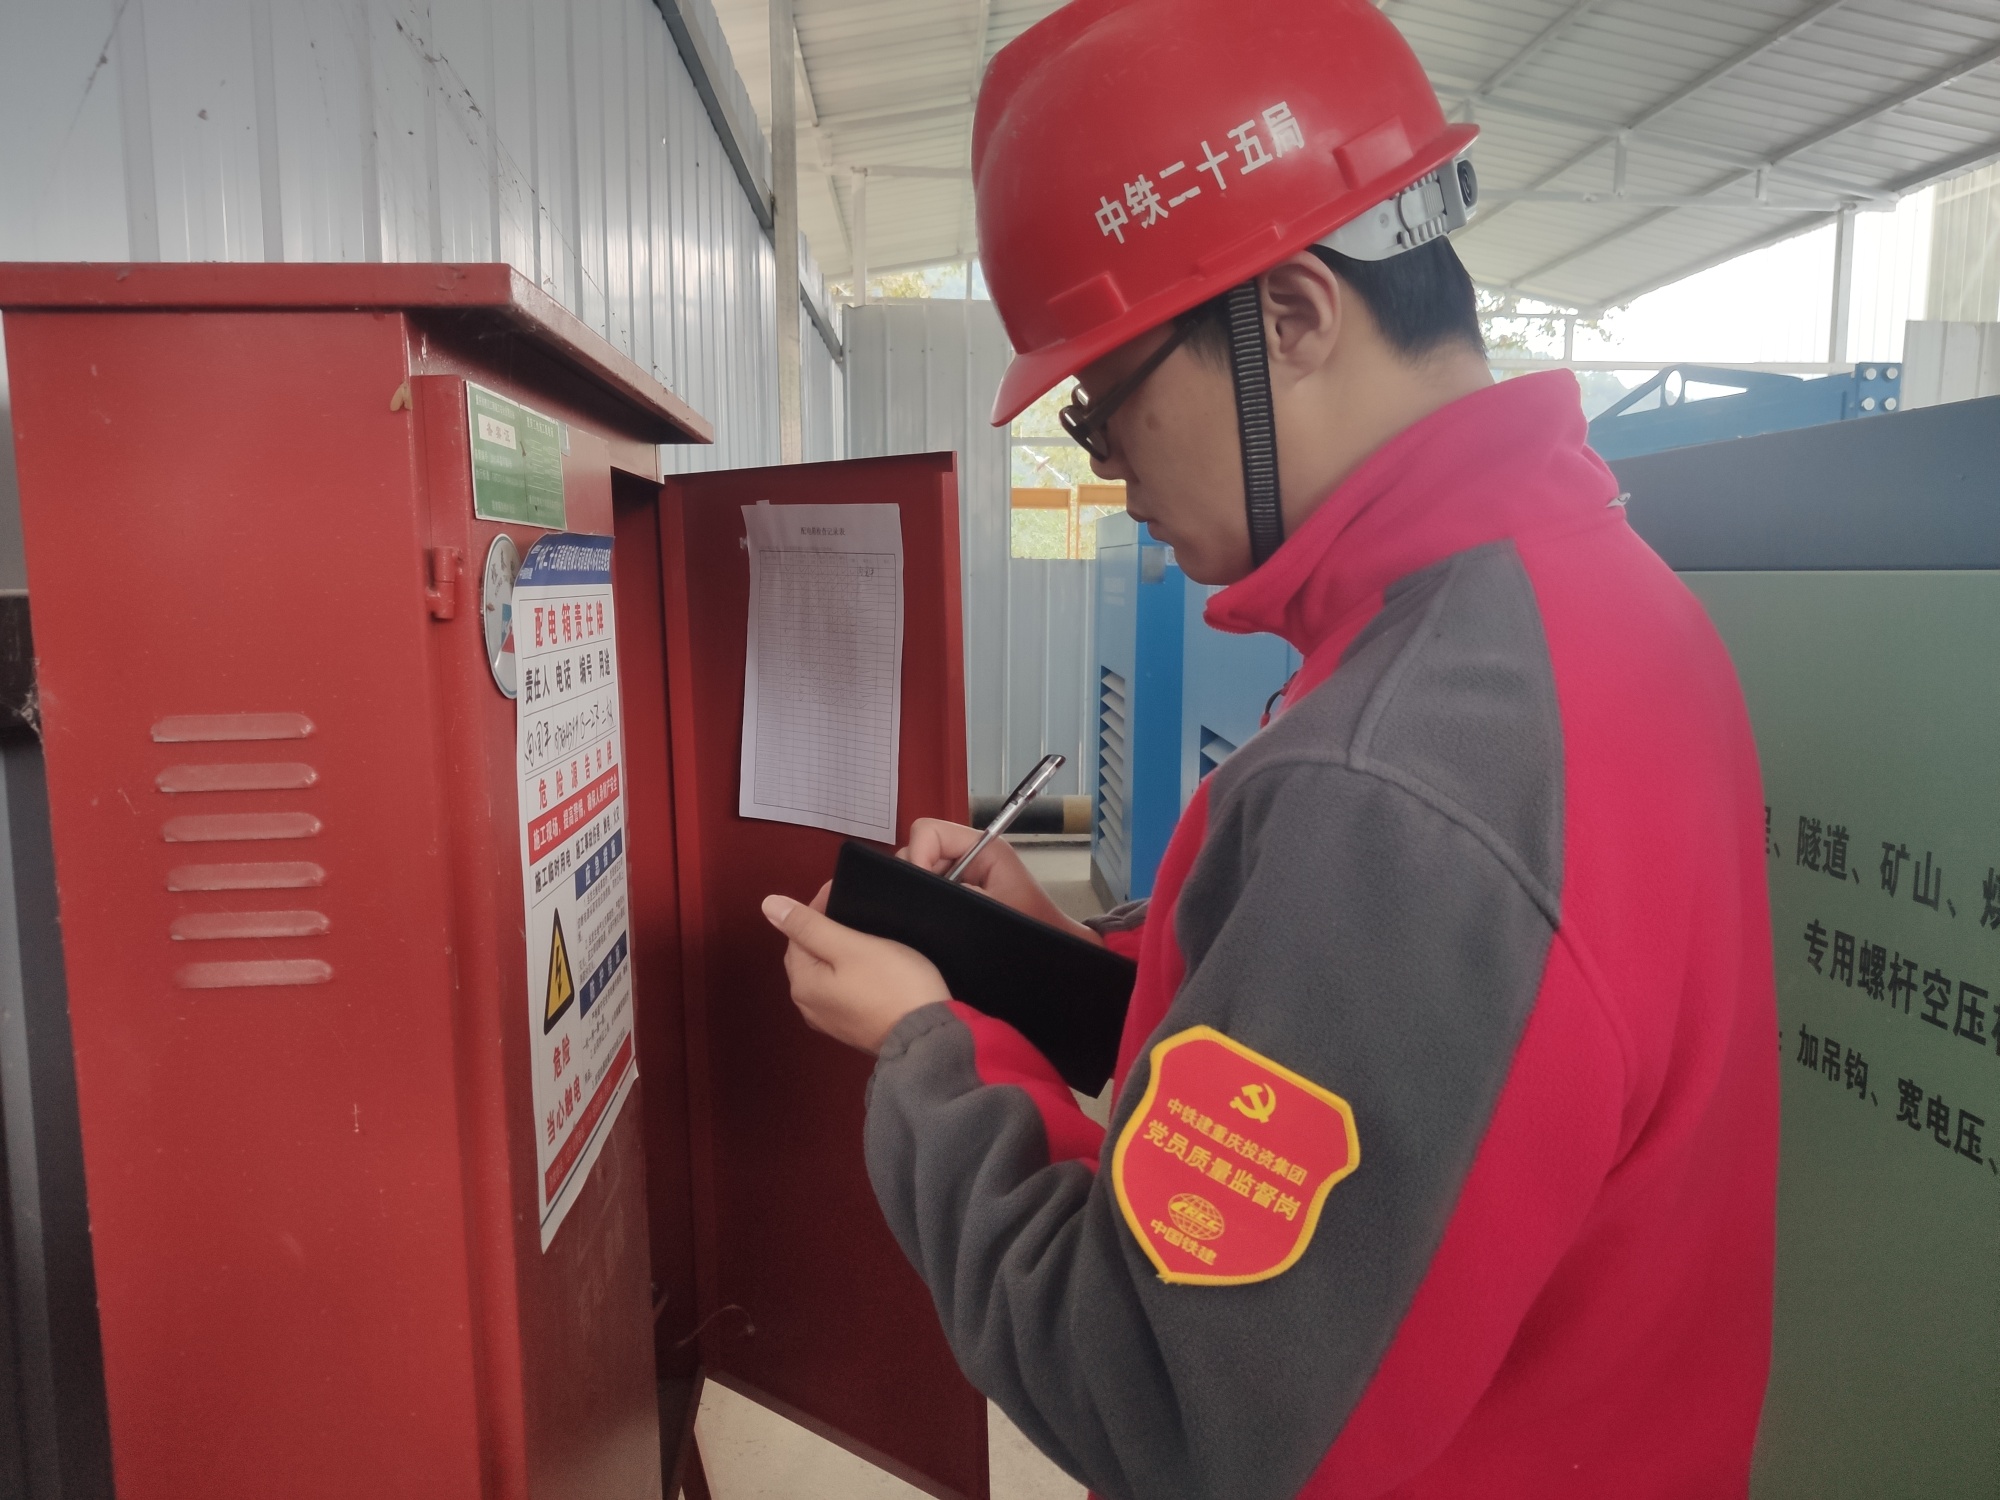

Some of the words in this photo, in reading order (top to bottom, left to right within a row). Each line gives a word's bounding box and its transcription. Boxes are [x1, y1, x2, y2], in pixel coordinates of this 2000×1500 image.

[1094, 101, 1305, 244] 中铁二十五局
[533, 600, 605, 648] 配电箱责任牌
[525, 665, 551, 705] 责任人
[555, 658, 572, 693] 电话
[1803, 918, 2000, 1057] 专用螺杆空压
[552, 1032, 571, 1081] 危险
[546, 1074, 582, 1146] 当心触电
[1167, 1098, 1309, 1187] 中铁建重庆投资集团
[1143, 1119, 1303, 1222] 党员质量监督岗
[1150, 1218, 1218, 1266] 中国铁建
